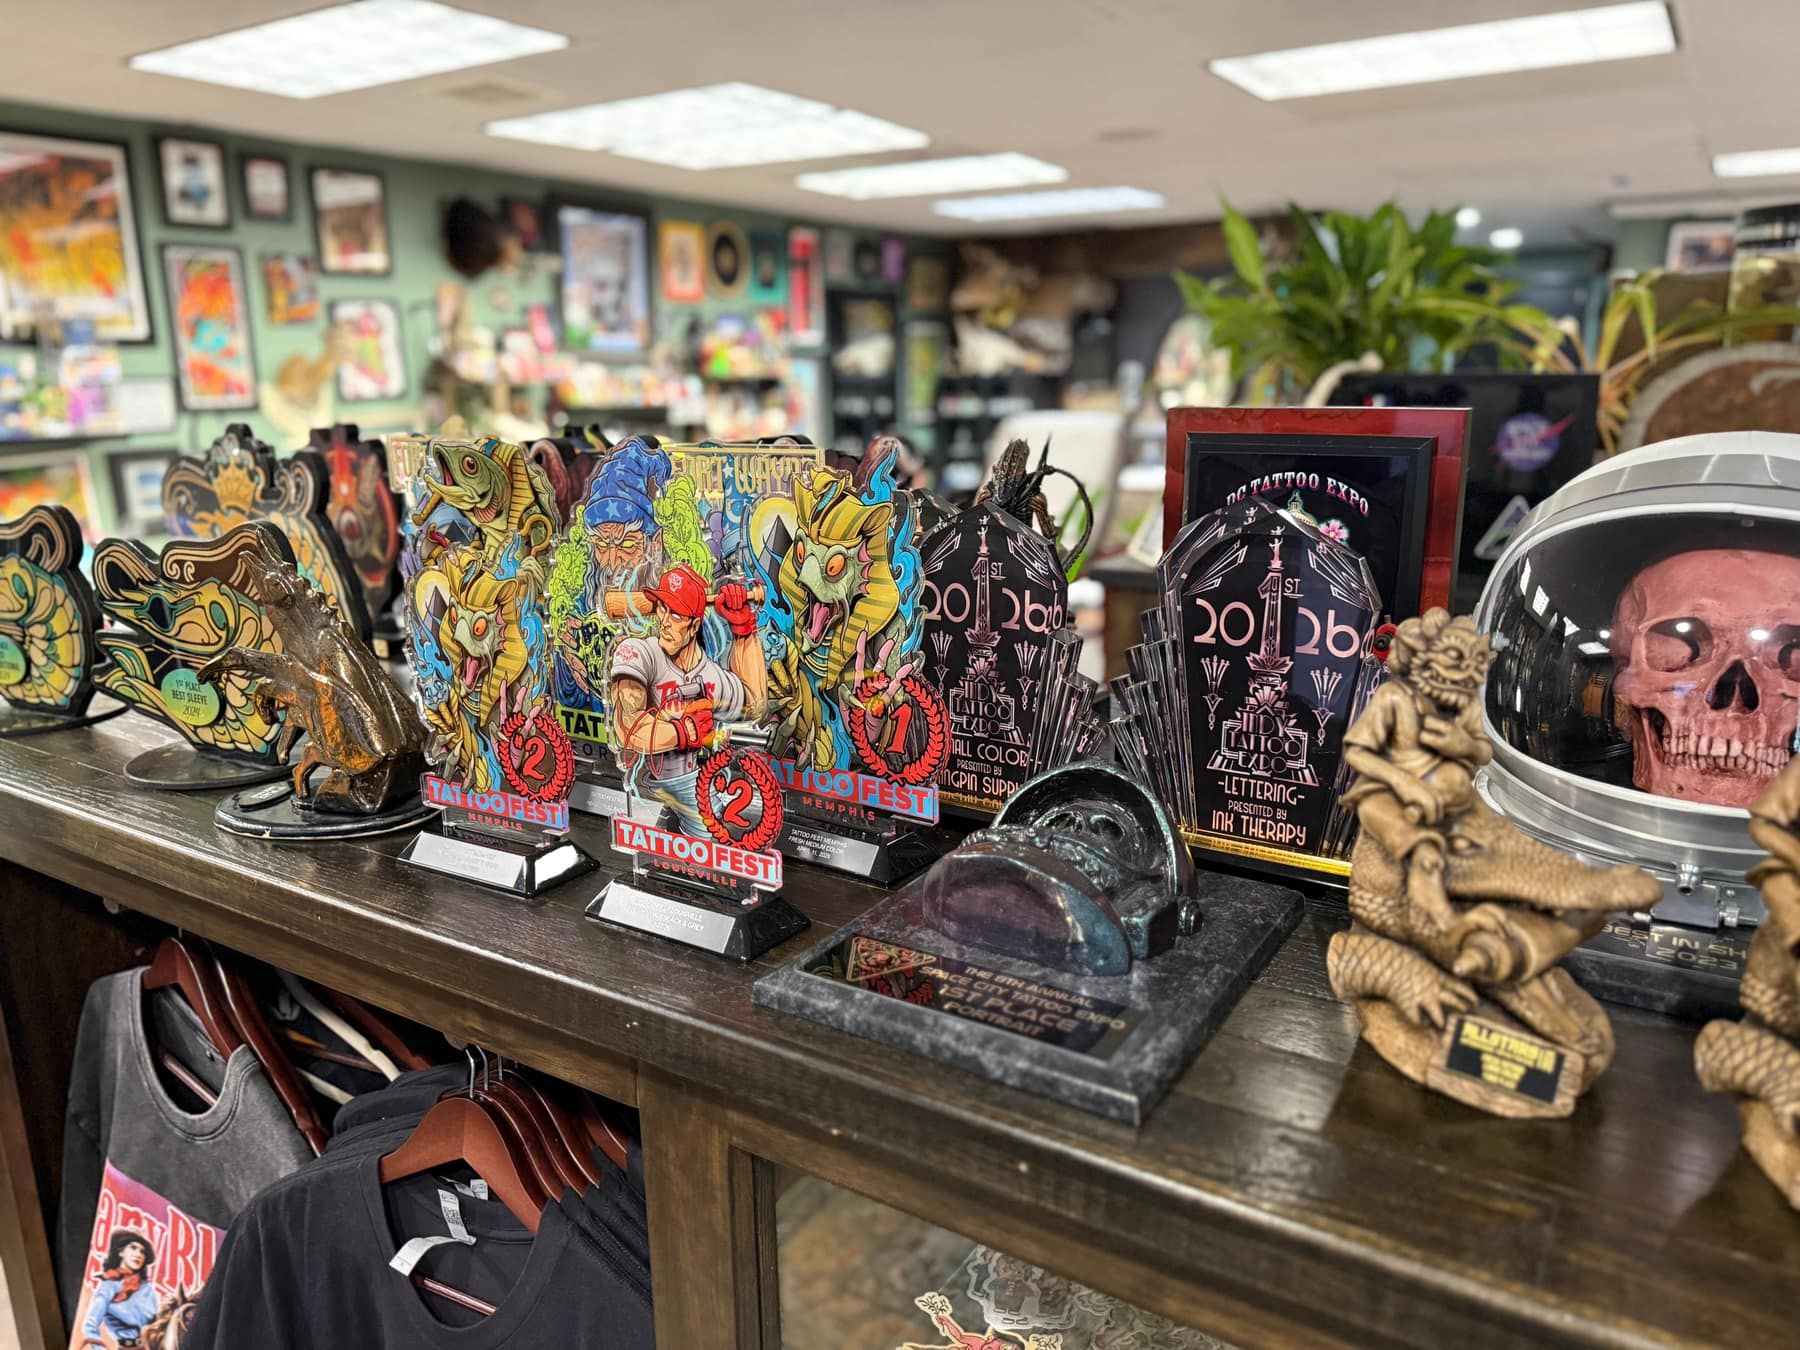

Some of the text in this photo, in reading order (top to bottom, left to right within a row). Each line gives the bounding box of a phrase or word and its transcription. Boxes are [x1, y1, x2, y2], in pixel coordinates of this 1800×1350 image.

[733, 455, 817, 495] WAYN
[1250, 471, 1320, 495] TATTOO
[1325, 476, 1369, 517] EXPO
[1194, 598, 1255, 647] 20
[172, 689, 208, 705] BEST SLEEVE
[185, 680, 201, 692] PLACE
[1229, 731, 1301, 757] TATTOO
[957, 759, 1002, 776] PRESENTED BY
[1238, 751, 1287, 774] EXPO
[938, 769, 978, 791] INGPIN
[430, 781, 505, 813] TATTOO
[512, 799, 558, 826] FEST
[803, 796, 877, 822] MEMPHIS
[862, 780, 929, 814] FEST
[1228, 800, 1287, 820] PRESENTED BY
[468, 812, 523, 832] MEMPHIS
[1212, 810, 1307, 846] INK THERAPY
[619, 824, 773, 880] TATTOO FEST
[653, 859, 737, 888] LOUISVILLE
[1672, 937, 1700, 950] IN
[1708, 944, 1747, 960] SH
[919, 966, 1126, 1031] SPACE CITY TATTOO EXPO
[964, 966, 993, 981] THE
[1026, 984, 1093, 1008] ANNUAL
[984, 997, 1079, 1033] PLACE
